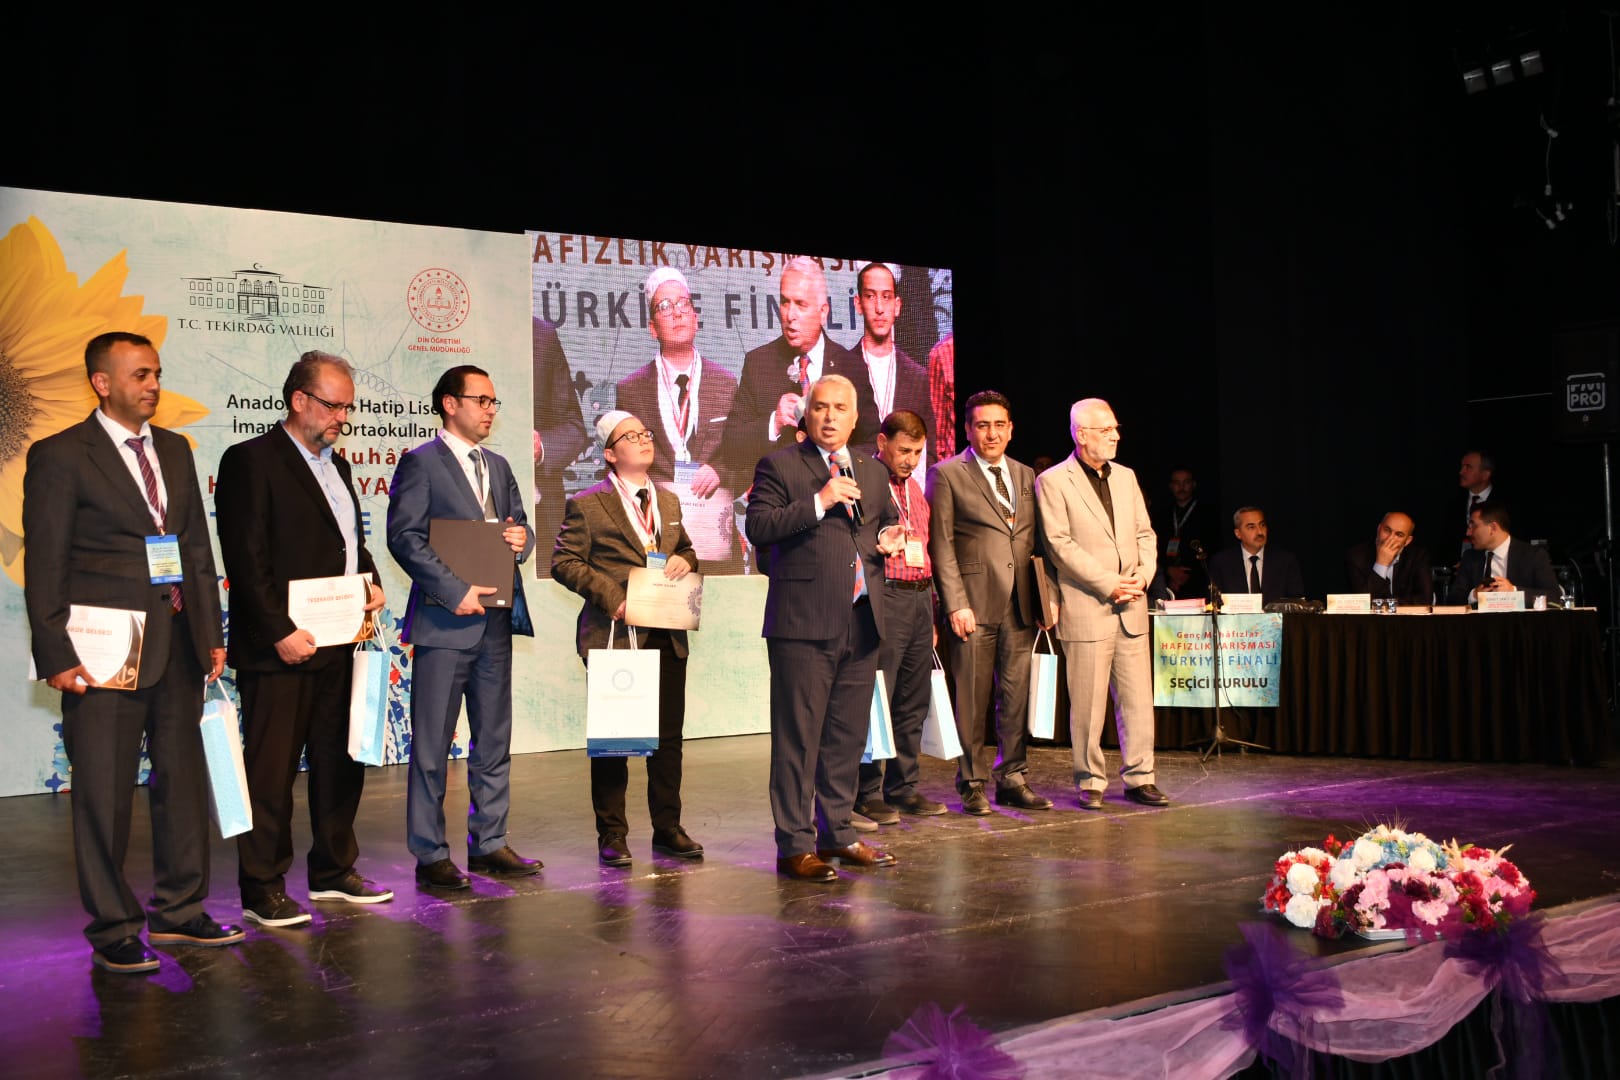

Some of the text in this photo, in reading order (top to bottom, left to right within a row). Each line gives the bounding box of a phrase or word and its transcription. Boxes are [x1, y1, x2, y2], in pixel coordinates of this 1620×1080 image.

[533, 234, 855, 276] AFIZLIK YARIŞSI
[541, 281, 857, 331] ÜRKİE FİNLİ
[177, 318, 335, 338] T.C. TEKİRDAĞ VALİLİĞİ
[408, 344, 429, 352] GENEL
[226, 394, 440, 418] Anado Hatip Lise
[1570, 391, 1602, 406] PRO
[340, 422, 438, 438] Ortaokulları
[1176, 630, 1260, 640] Genç Mhâfızlar
[1161, 642, 1212, 651] HAFIZLIK
[1228, 652, 1278, 666] FİNALİ
[1169, 675, 1210, 692] SEÇİCİ
